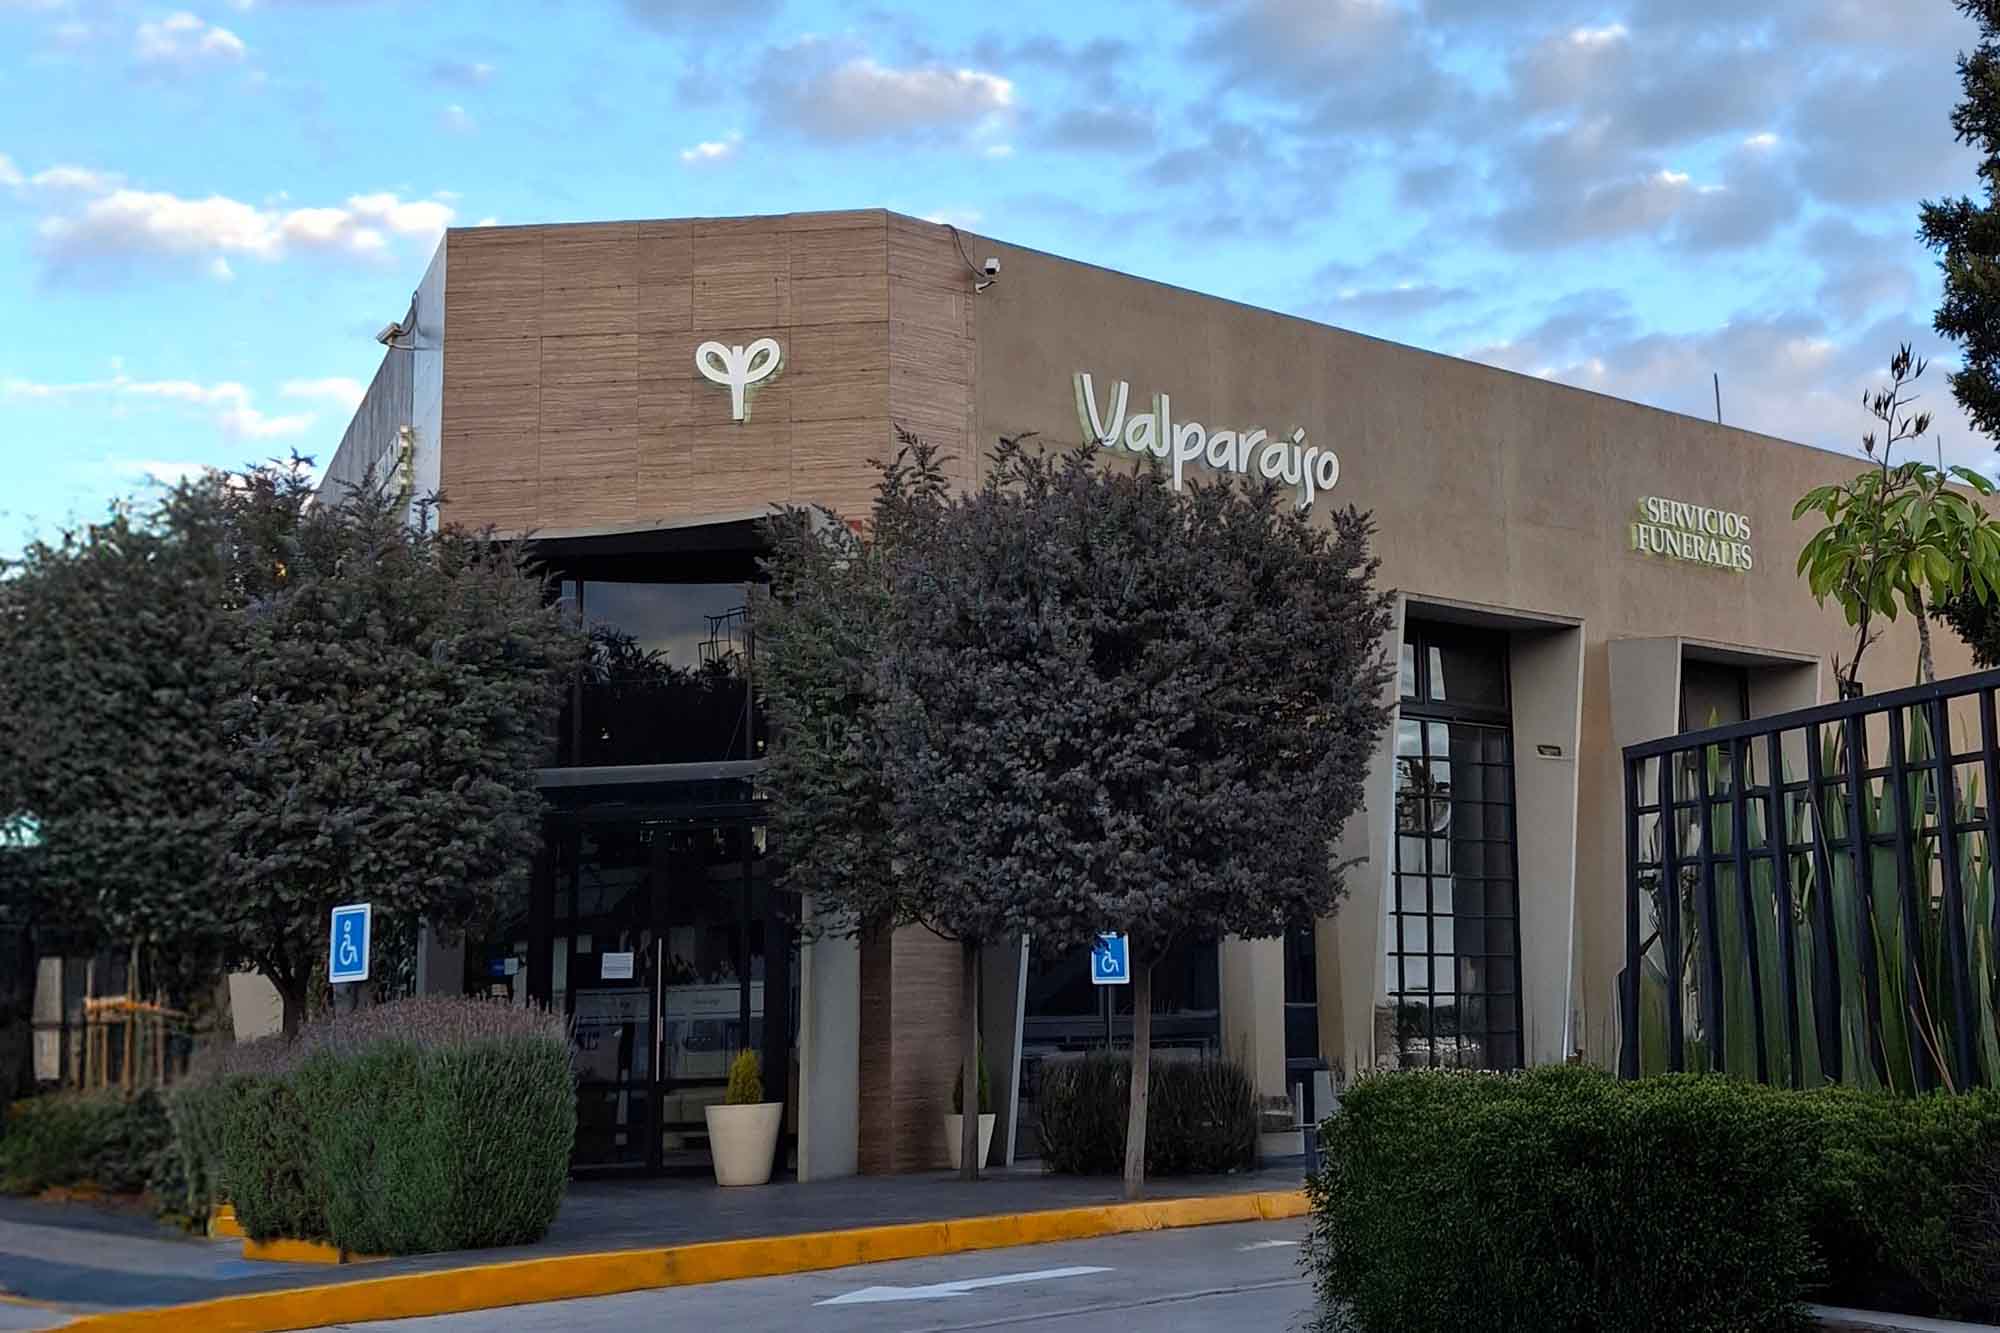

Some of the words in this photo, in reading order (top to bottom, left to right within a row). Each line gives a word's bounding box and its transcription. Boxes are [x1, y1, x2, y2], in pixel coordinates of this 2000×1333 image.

[1081, 373, 1340, 509] Valparaíso
[1647, 496, 1751, 540] SERVICIOS
[1637, 523, 1753, 570] FUNERALES
